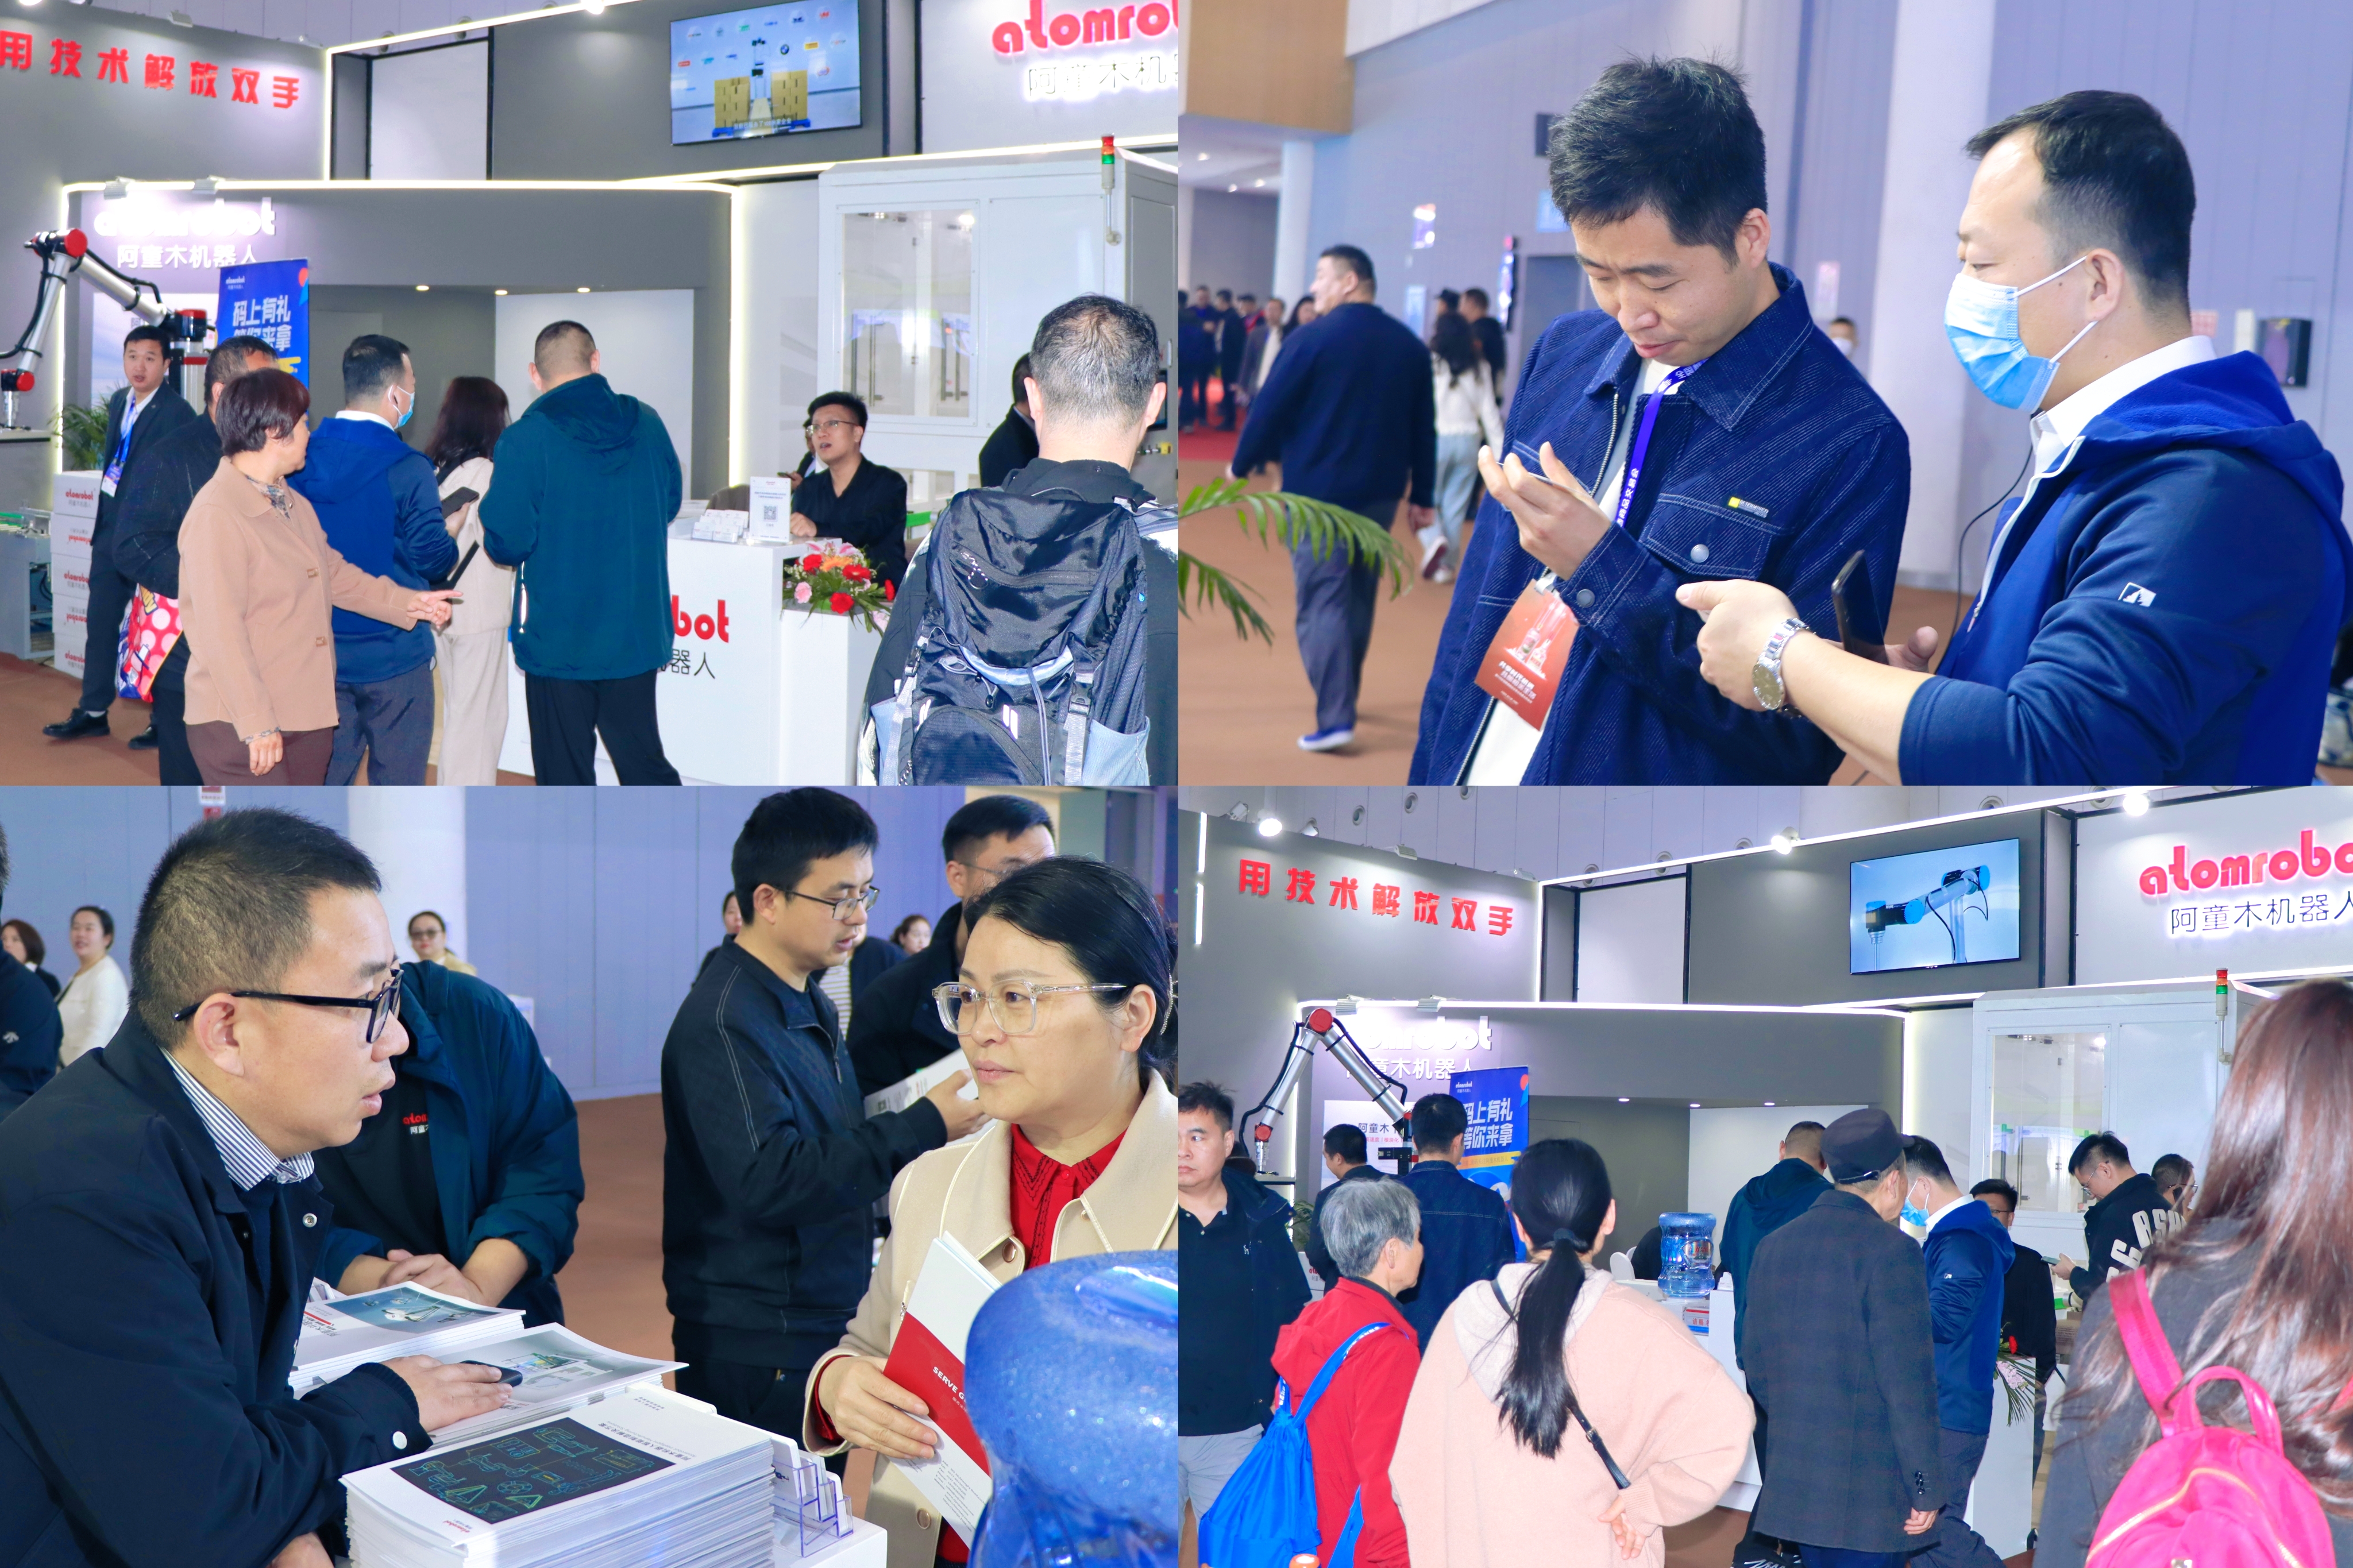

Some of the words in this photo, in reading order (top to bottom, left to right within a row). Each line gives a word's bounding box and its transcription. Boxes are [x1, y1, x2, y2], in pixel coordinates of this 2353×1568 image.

[0, 30, 299, 109] 用技术解放双手
[117, 244, 257, 269] 阿童木机器人
[233, 295, 291, 326] 码上有礼
[661, 648, 716, 679] 器人
[1239, 859, 1514, 936] 用技术解放双手
[2171, 890, 2353, 934] 阿童木机器人
[1347, 1057, 1473, 1080] 童木机器人
[1359, 1123, 1398, 1134] 阿童木
[1464, 1123, 1514, 1149] 等你来拿
[932, 1366, 958, 1393] SERVE
